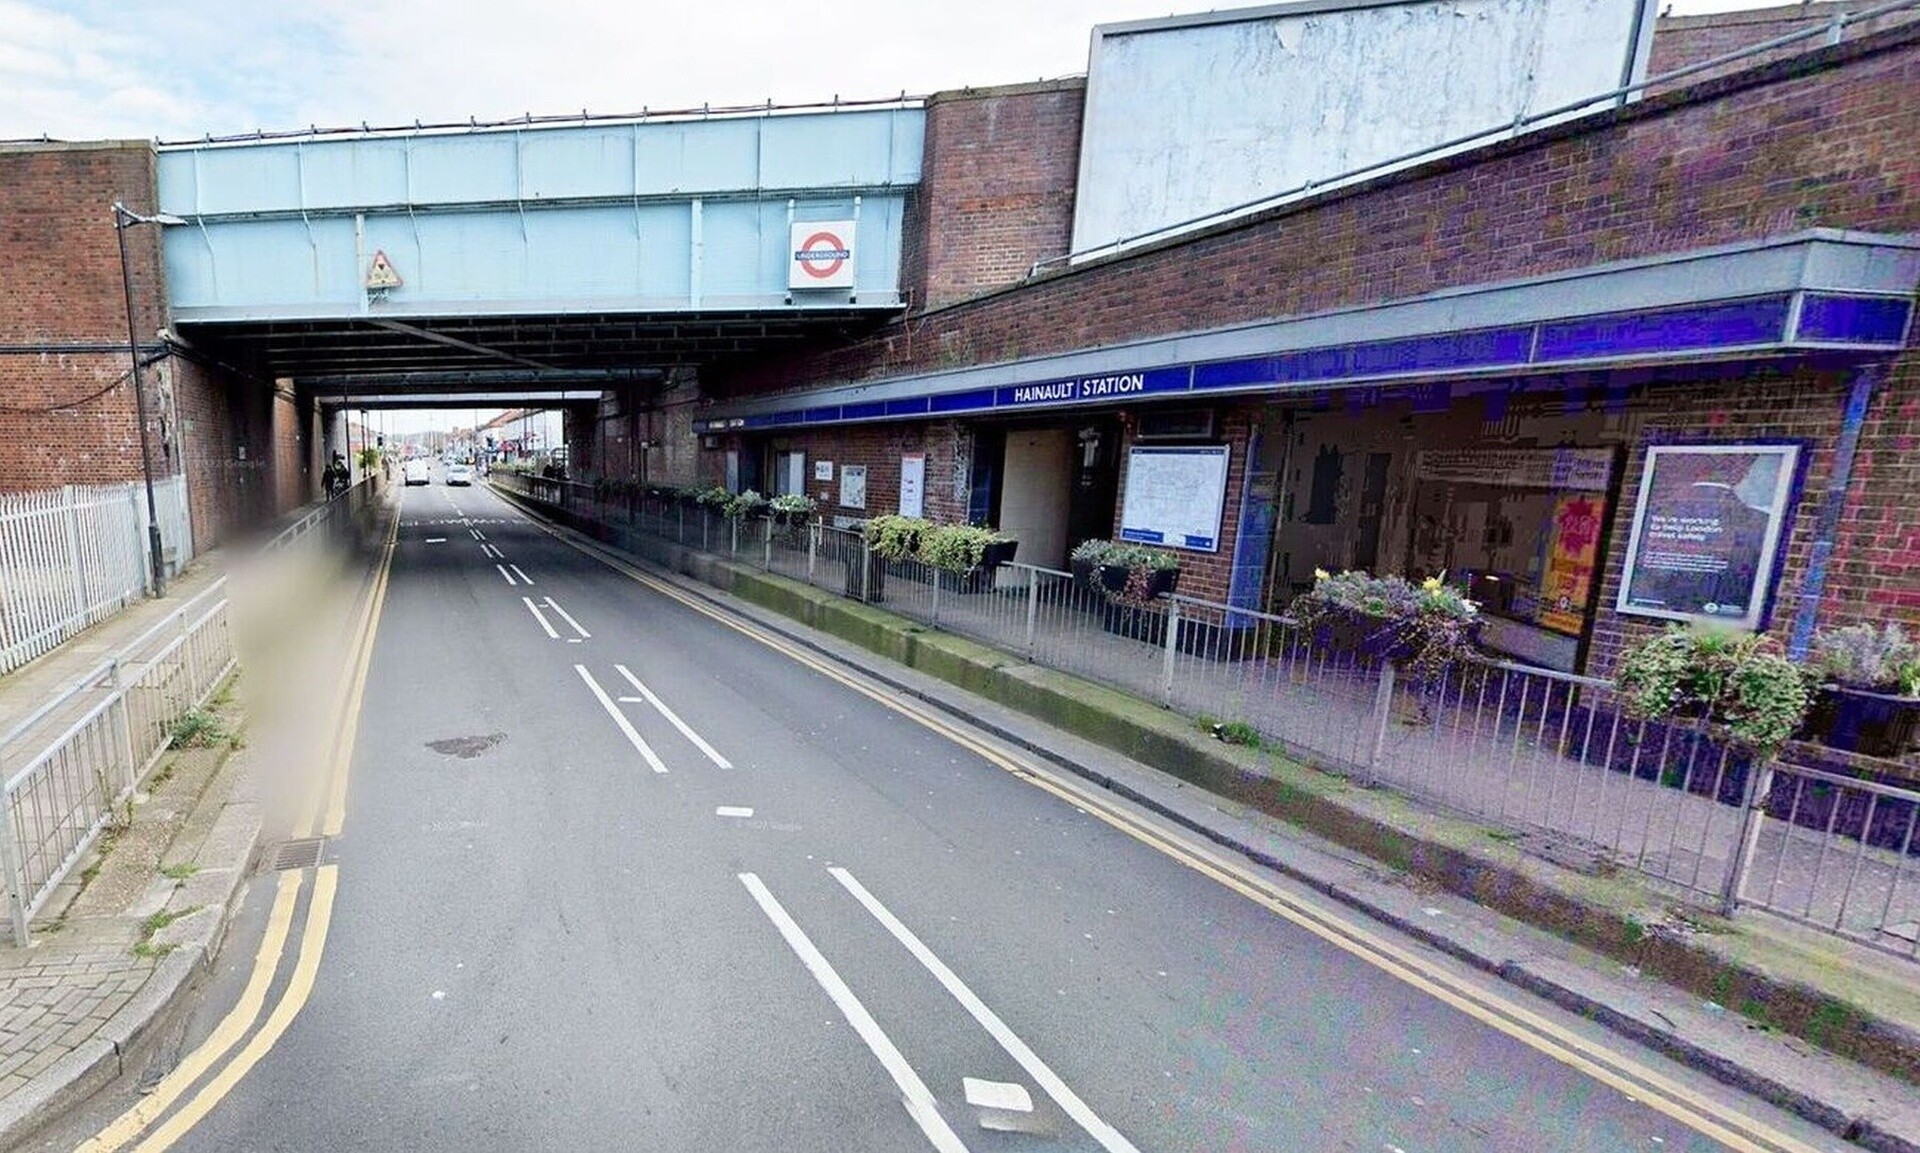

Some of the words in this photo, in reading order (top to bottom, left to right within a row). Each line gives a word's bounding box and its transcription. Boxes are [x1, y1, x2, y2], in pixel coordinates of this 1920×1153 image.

[797, 251, 848, 259] UNDERGROUND
[1015, 382, 1074, 402] HAINAULT
[1082, 374, 1145, 396] STATION
[1685, 524, 1724, 534] London
